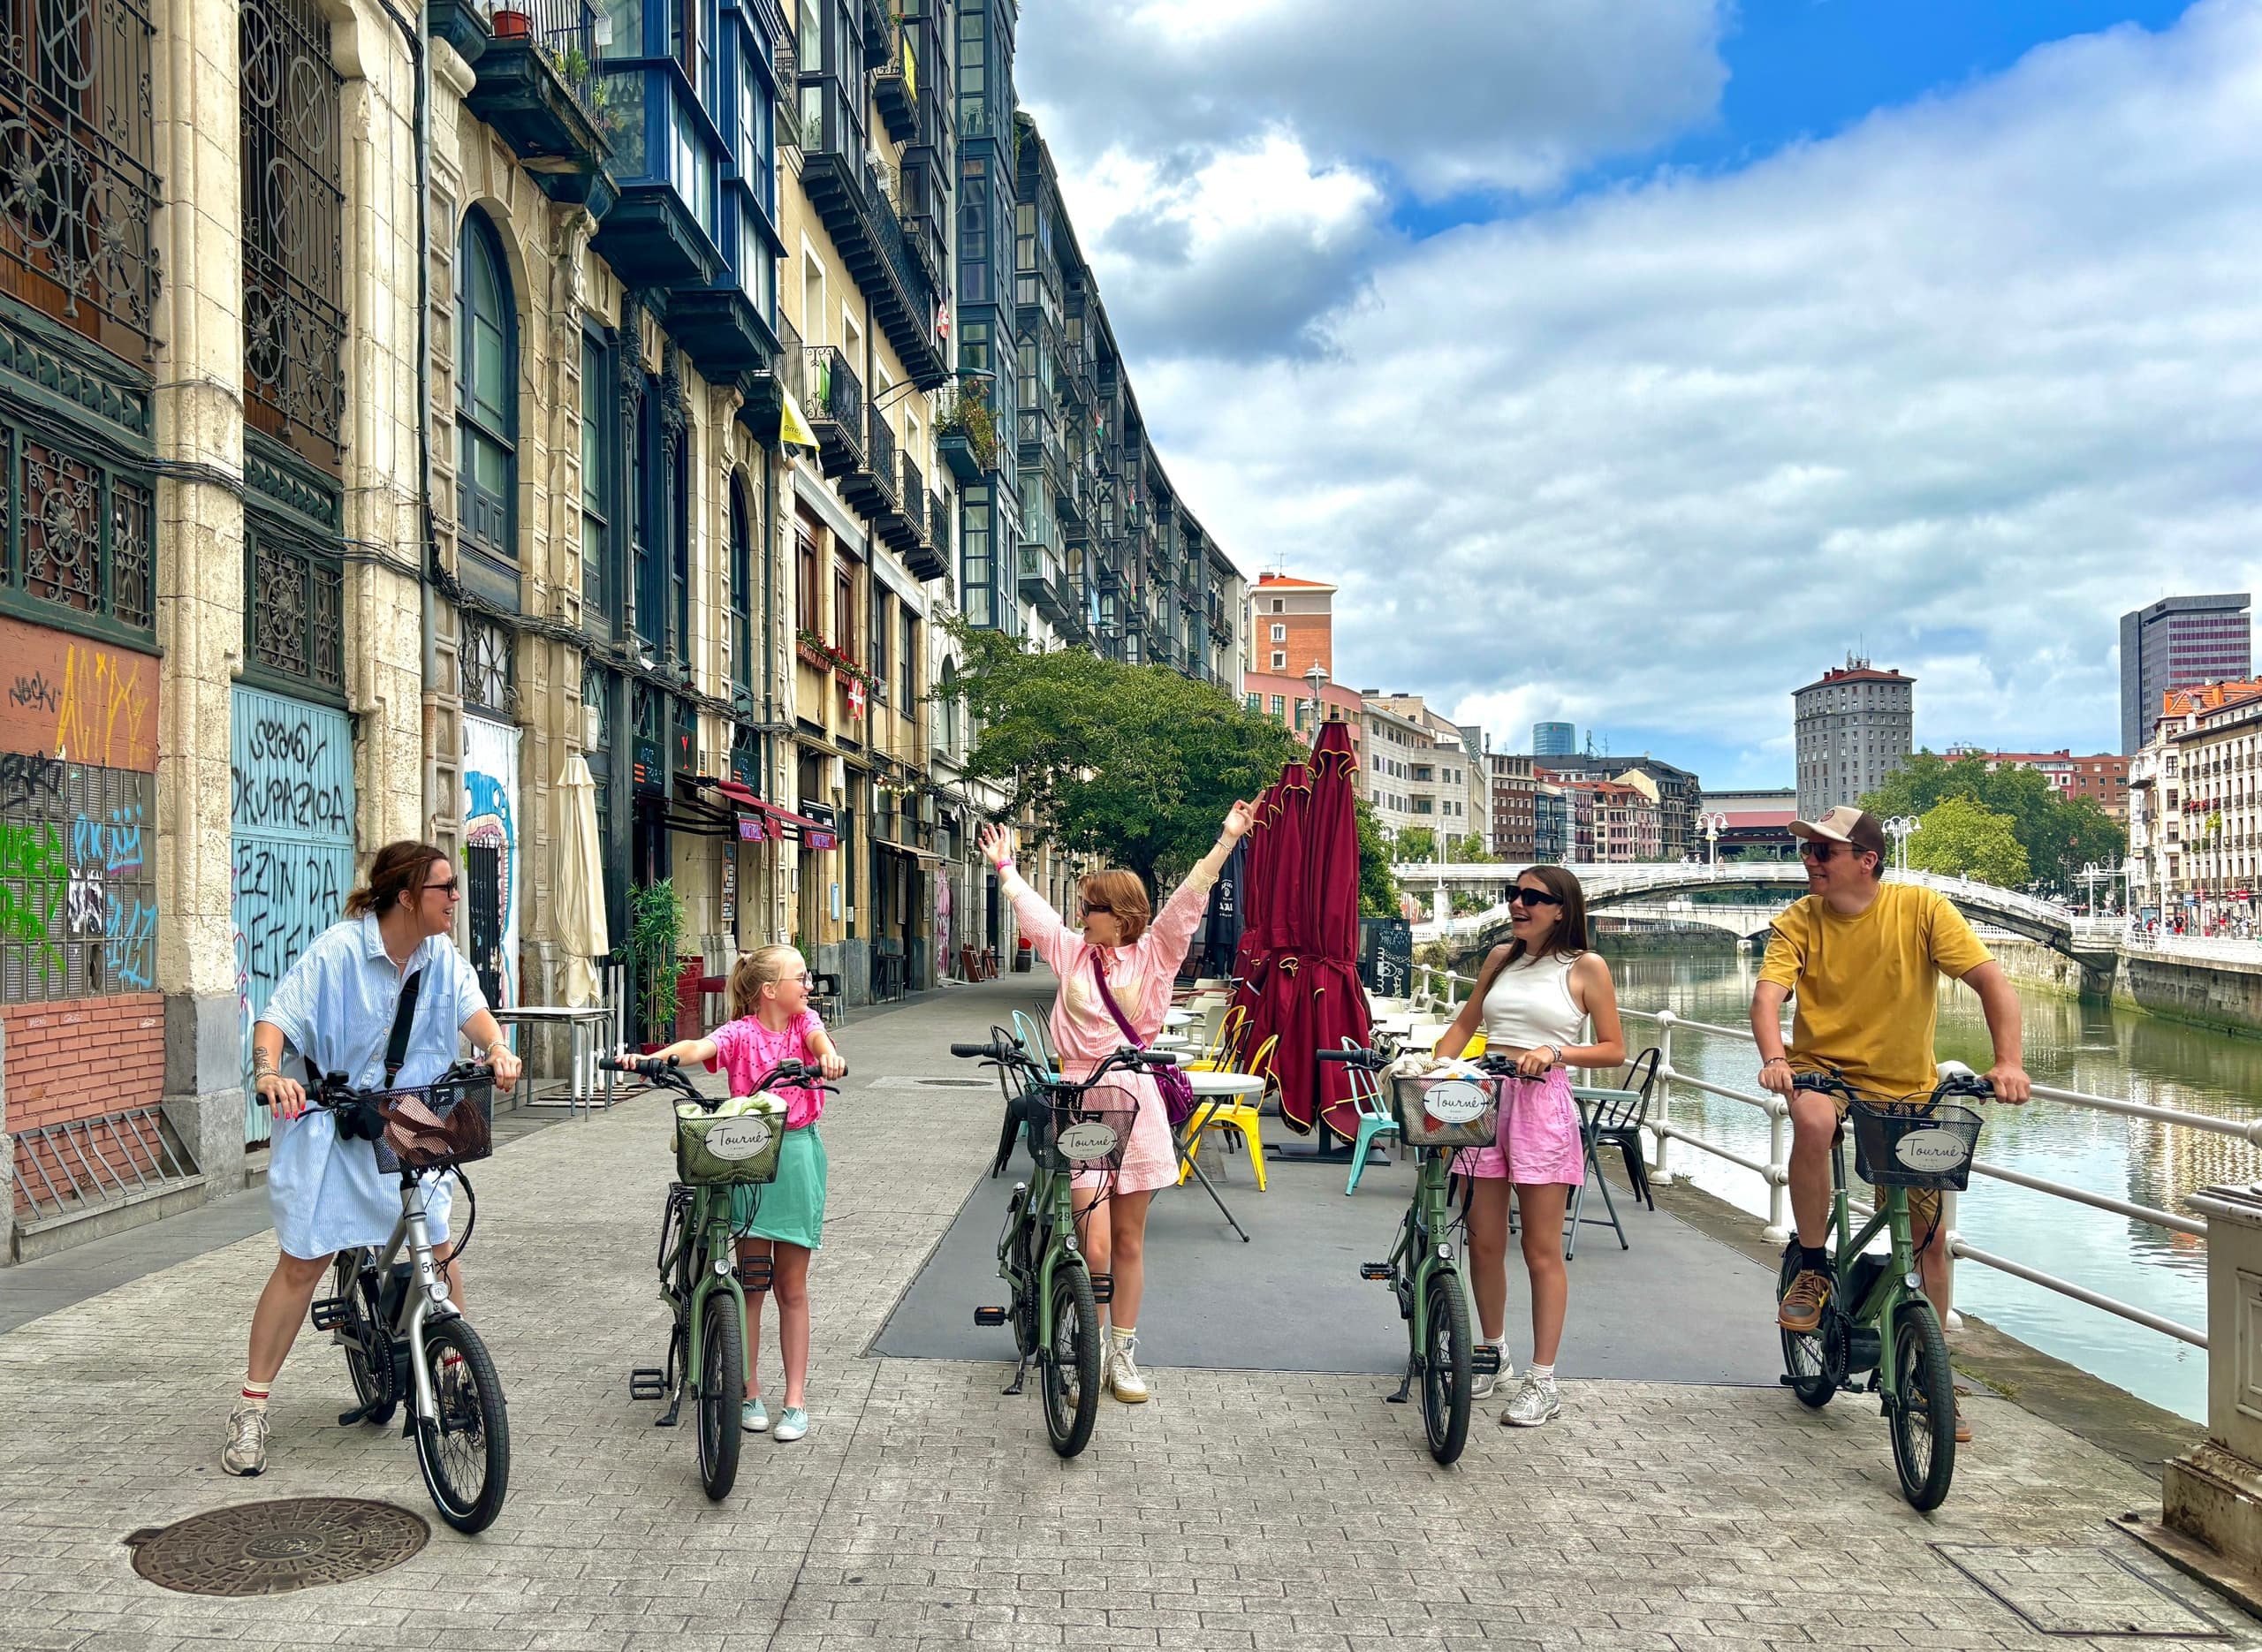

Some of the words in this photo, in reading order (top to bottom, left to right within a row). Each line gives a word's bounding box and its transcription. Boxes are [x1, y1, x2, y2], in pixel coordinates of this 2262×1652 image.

[239, 845, 297, 906] EZIN
[307, 857, 339, 914] DA
[252, 912, 330, 981] ETE
[1430, 1089, 1479, 1108] Tourné
[714, 1127, 764, 1147] Tourné
[1064, 1132, 1111, 1148] Tourné
[1902, 1138, 1959, 1157] Tourné
[1058, 1212, 1071, 1222] 29
[1431, 1224, 1446, 1235] 33
[421, 1262, 435, 1274] 51
